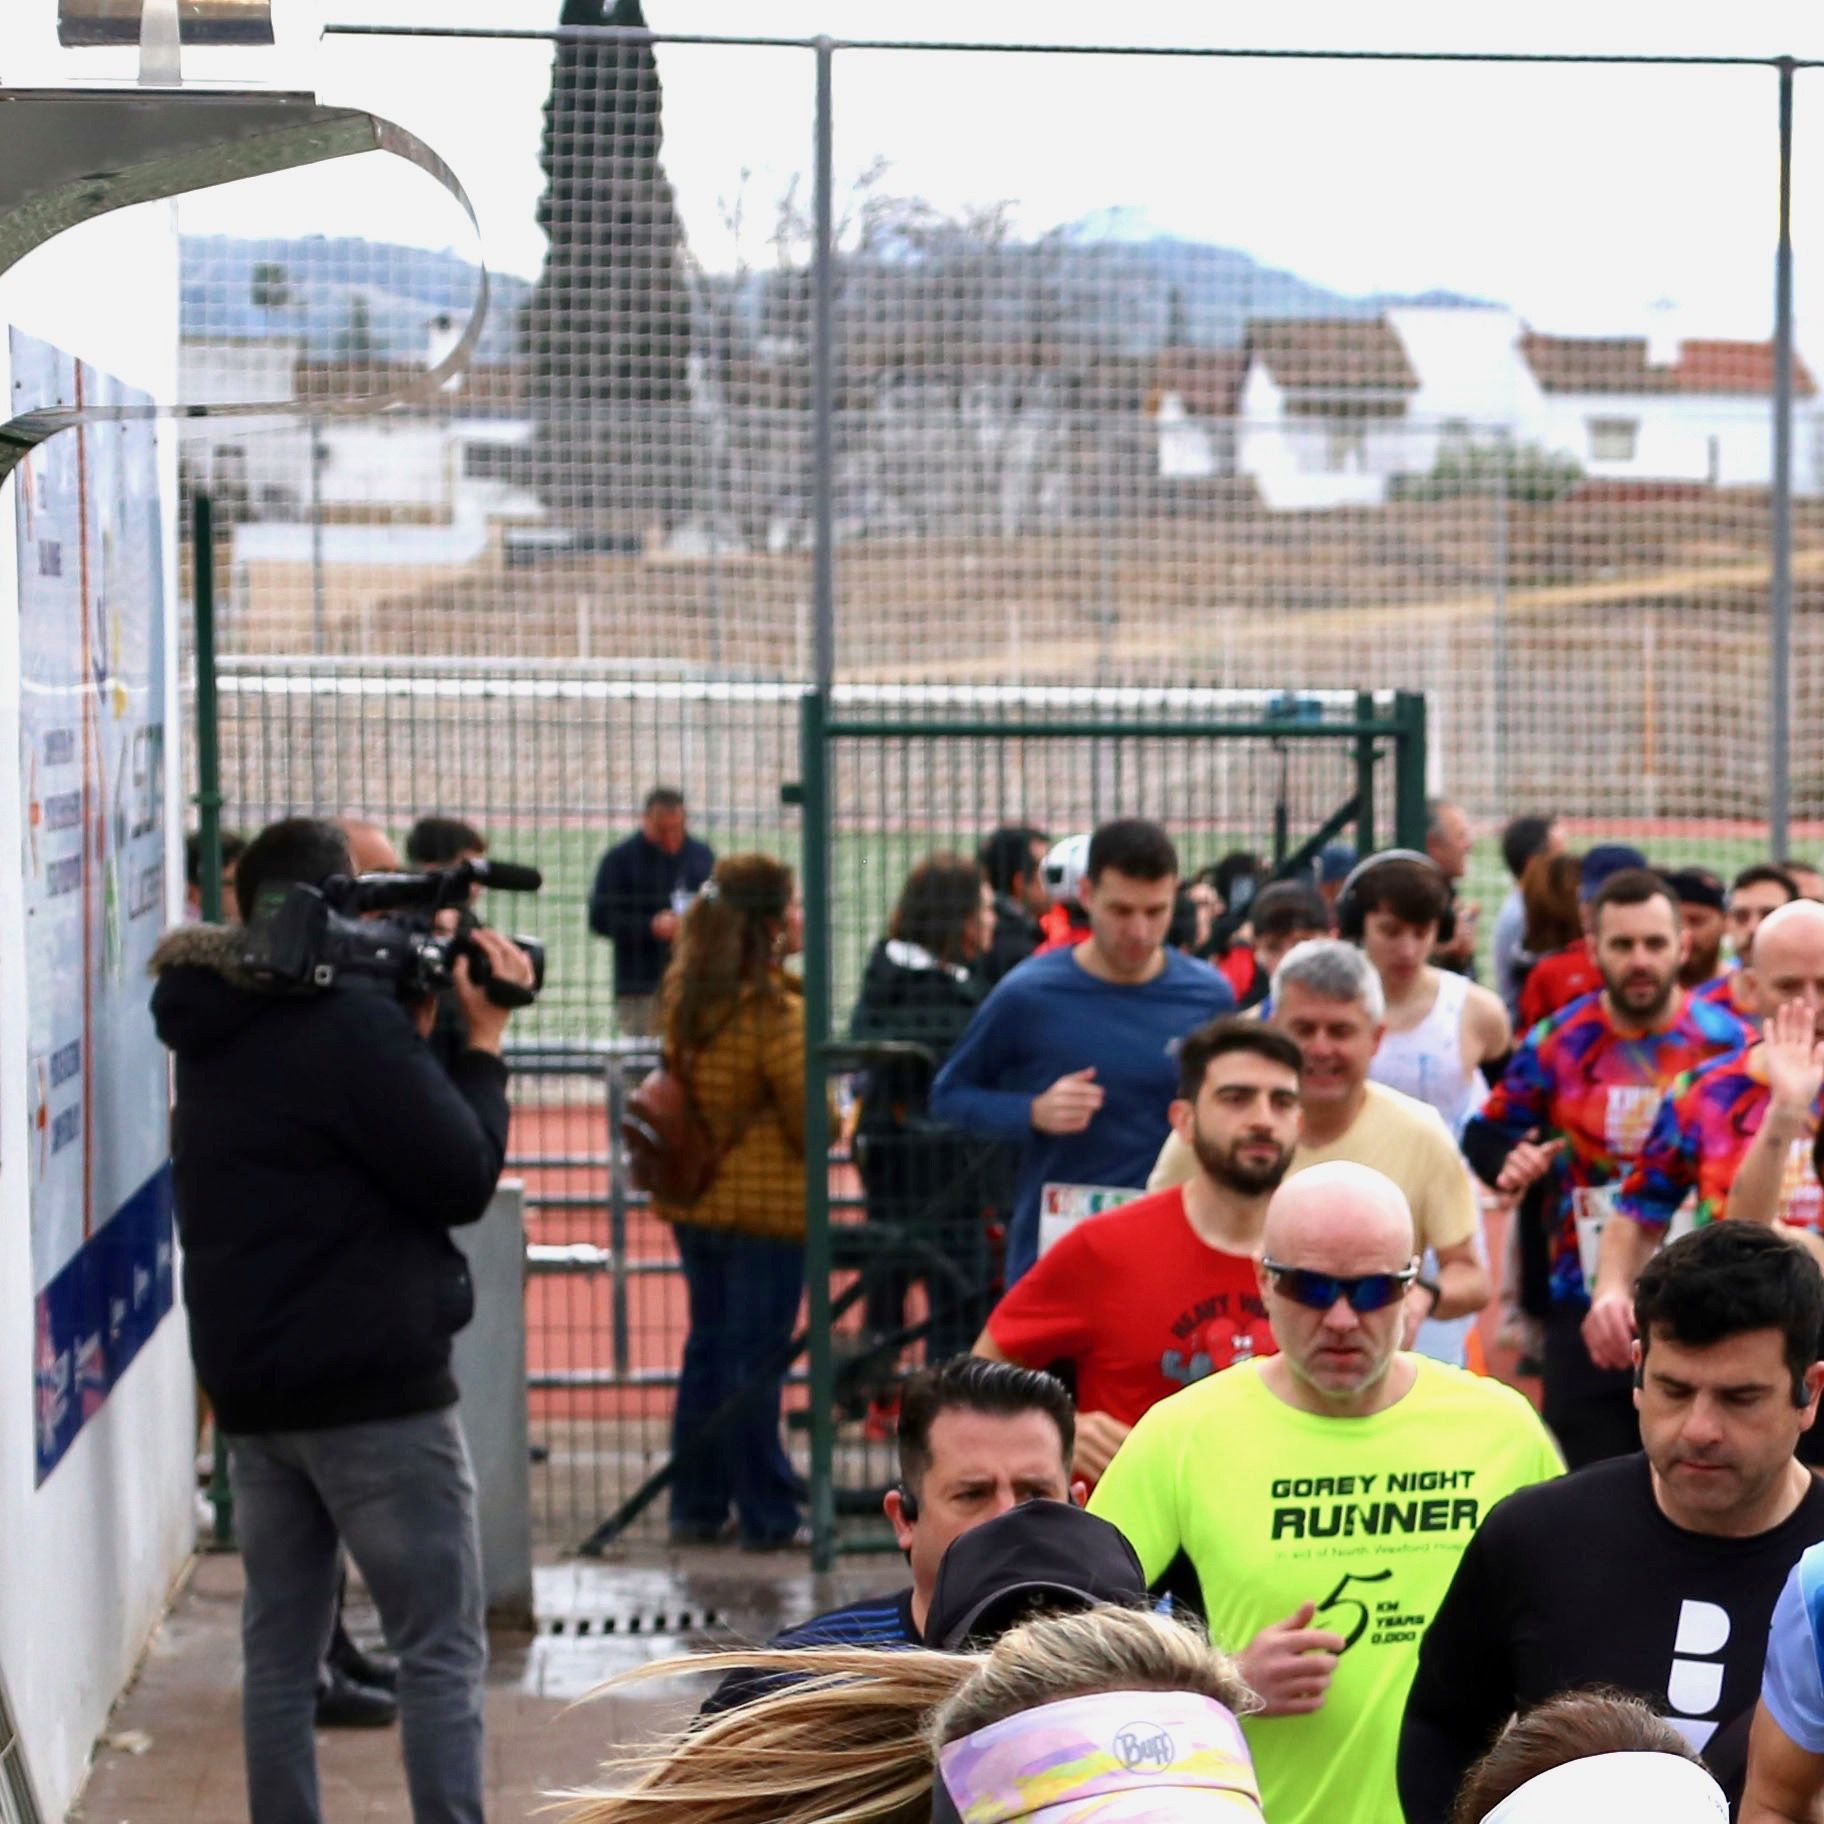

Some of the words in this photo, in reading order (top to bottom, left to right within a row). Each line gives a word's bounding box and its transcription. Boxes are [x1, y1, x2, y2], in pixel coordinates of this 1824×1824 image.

[1271, 1475, 1378, 1499] GOREY
[1388, 1470, 1476, 1492] NIGHT
[1317, 1568, 1393, 1657] 5
[1375, 1614, 1425, 1628] YEARS
[1119, 1732, 1170, 1767] Buff
